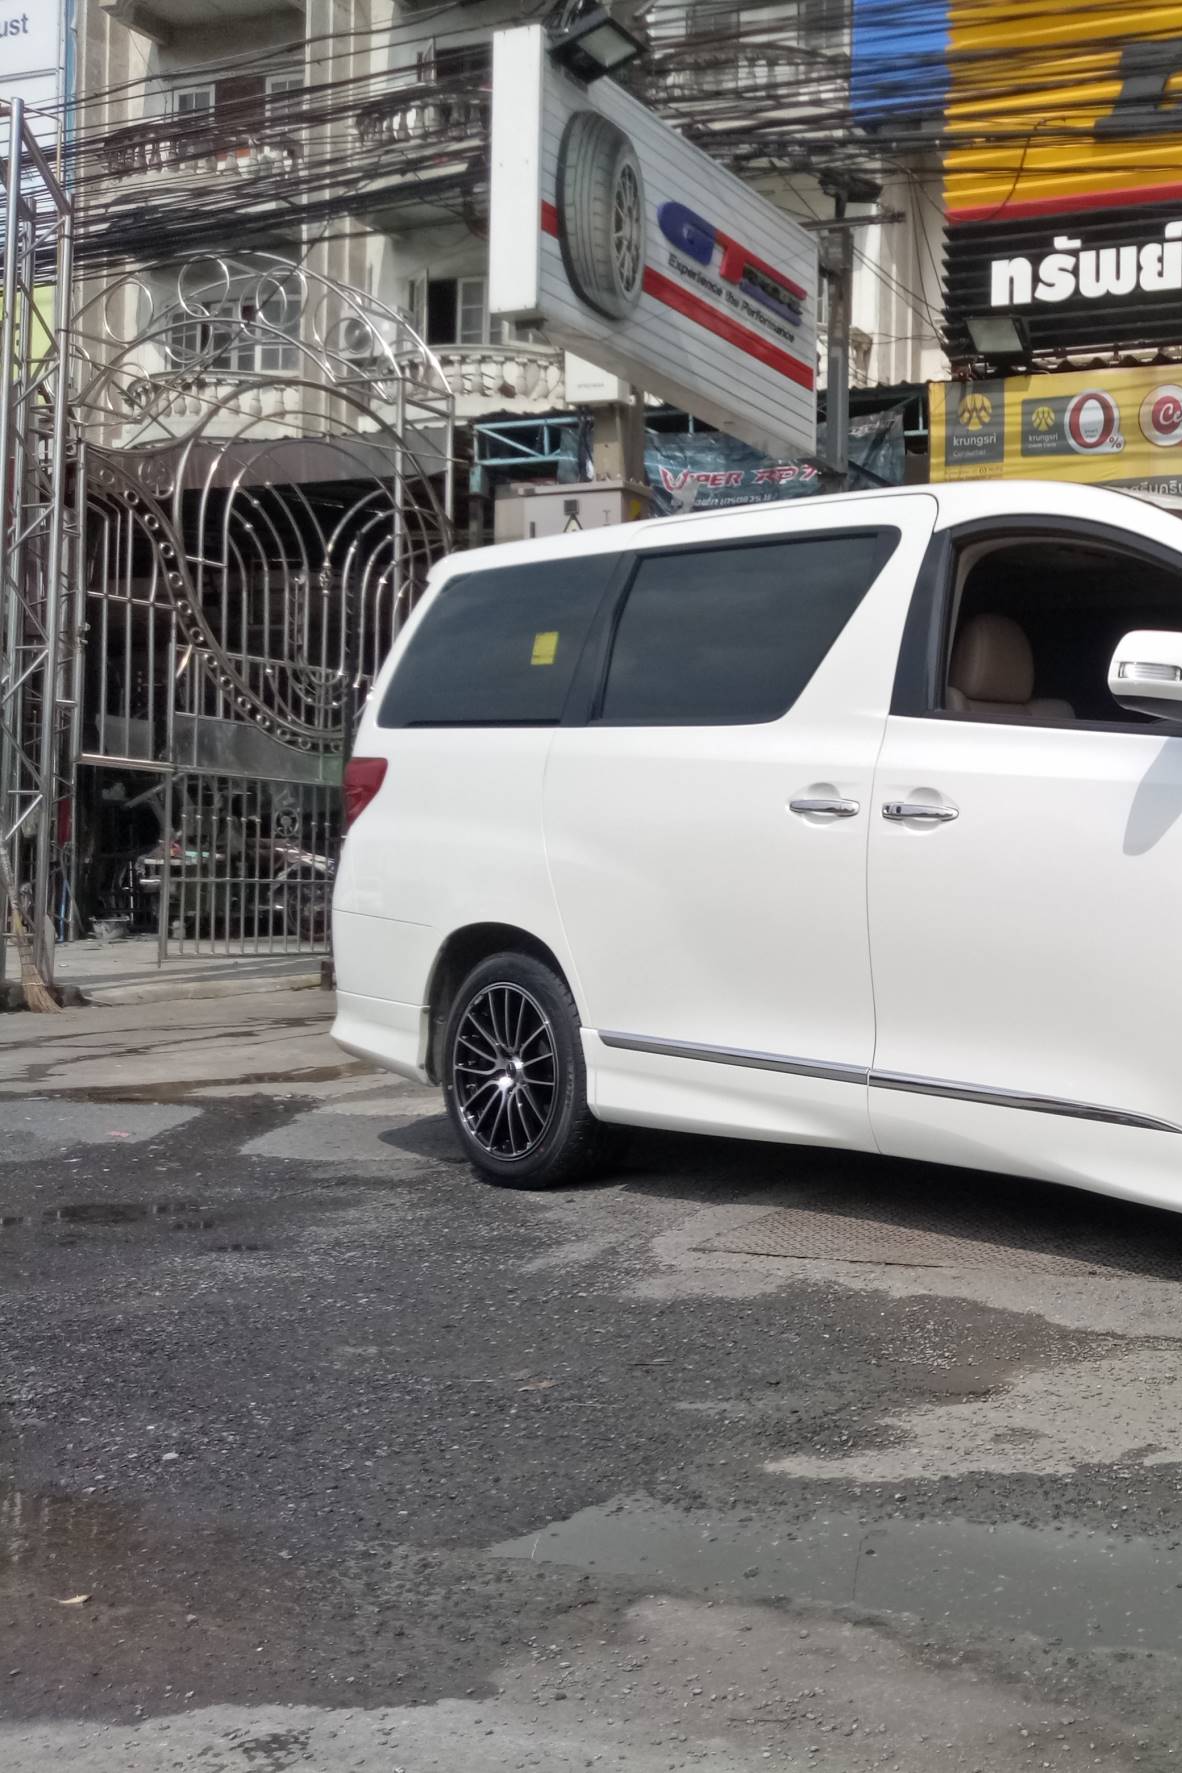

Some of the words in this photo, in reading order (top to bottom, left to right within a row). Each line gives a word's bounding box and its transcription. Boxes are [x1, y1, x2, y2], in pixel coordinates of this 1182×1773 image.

[668, 252, 723, 297] Experience
[725, 288, 740, 307] the
[740, 300, 796, 343] Performance
[952, 432, 996, 447] krungsri
